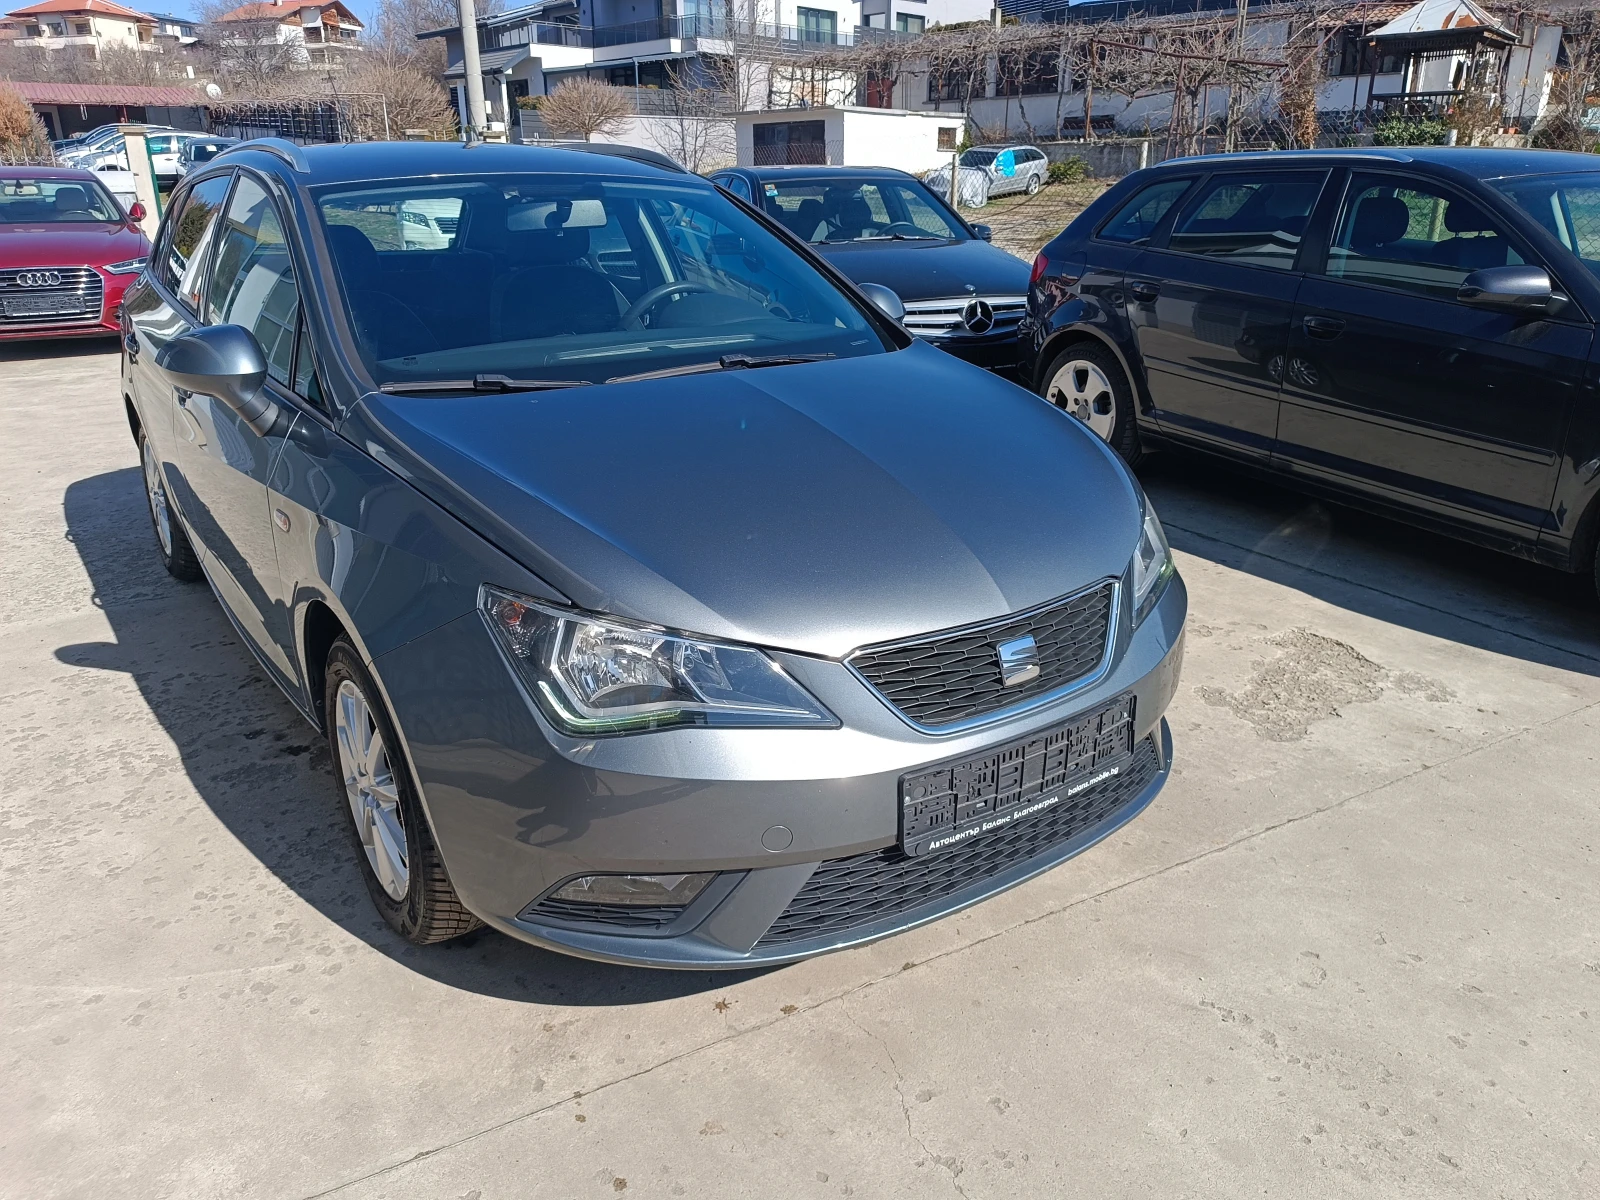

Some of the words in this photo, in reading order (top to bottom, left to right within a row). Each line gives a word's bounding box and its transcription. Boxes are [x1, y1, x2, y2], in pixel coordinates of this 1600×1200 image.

[929, 827, 980, 850] Автоцентър
[982, 816, 1011, 830] Баланс
[1013, 796, 1059, 819] Благоевград
[1067, 767, 1119, 796] balans.mobile.bg
